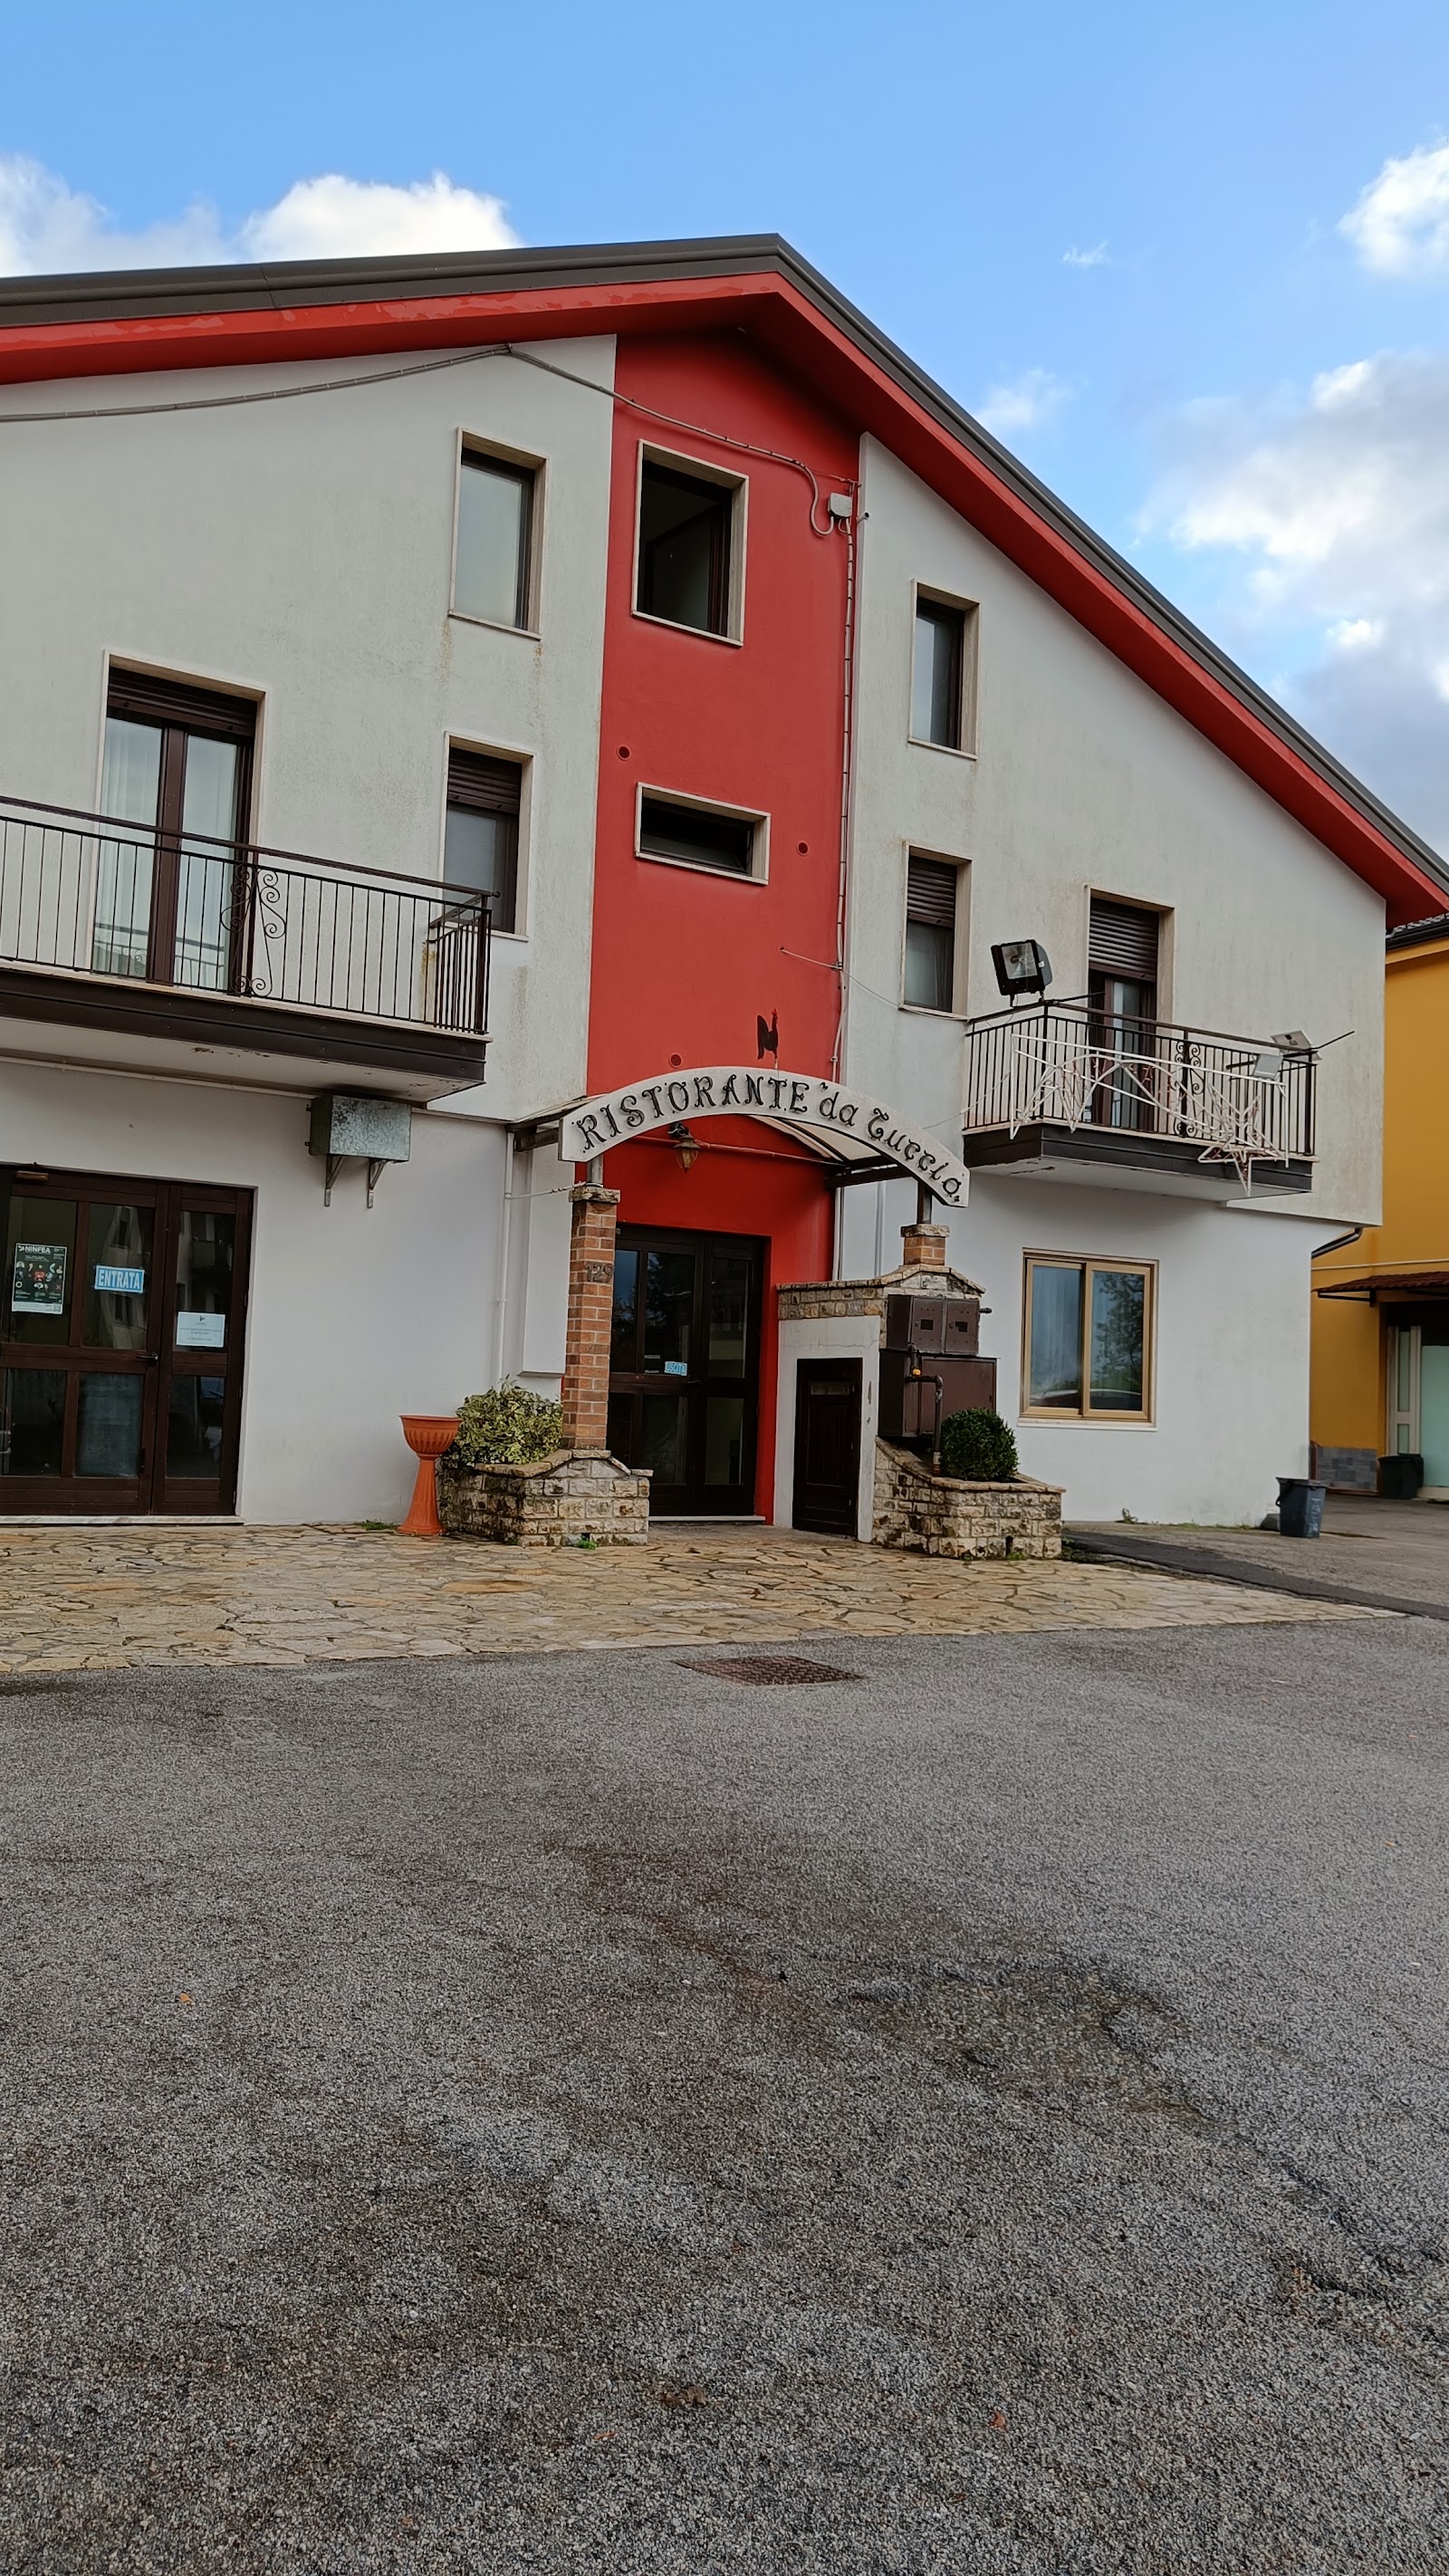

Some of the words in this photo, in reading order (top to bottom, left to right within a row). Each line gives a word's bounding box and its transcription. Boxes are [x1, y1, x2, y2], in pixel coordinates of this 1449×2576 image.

[573, 1074, 811, 1152] RISTORANTE
[24, 1245, 51, 1254] NINFEA
[98, 1270, 140, 1290] ENTRATA
[584, 1262, 614, 1283] 129
[667, 1362, 686, 1375] USCITA
